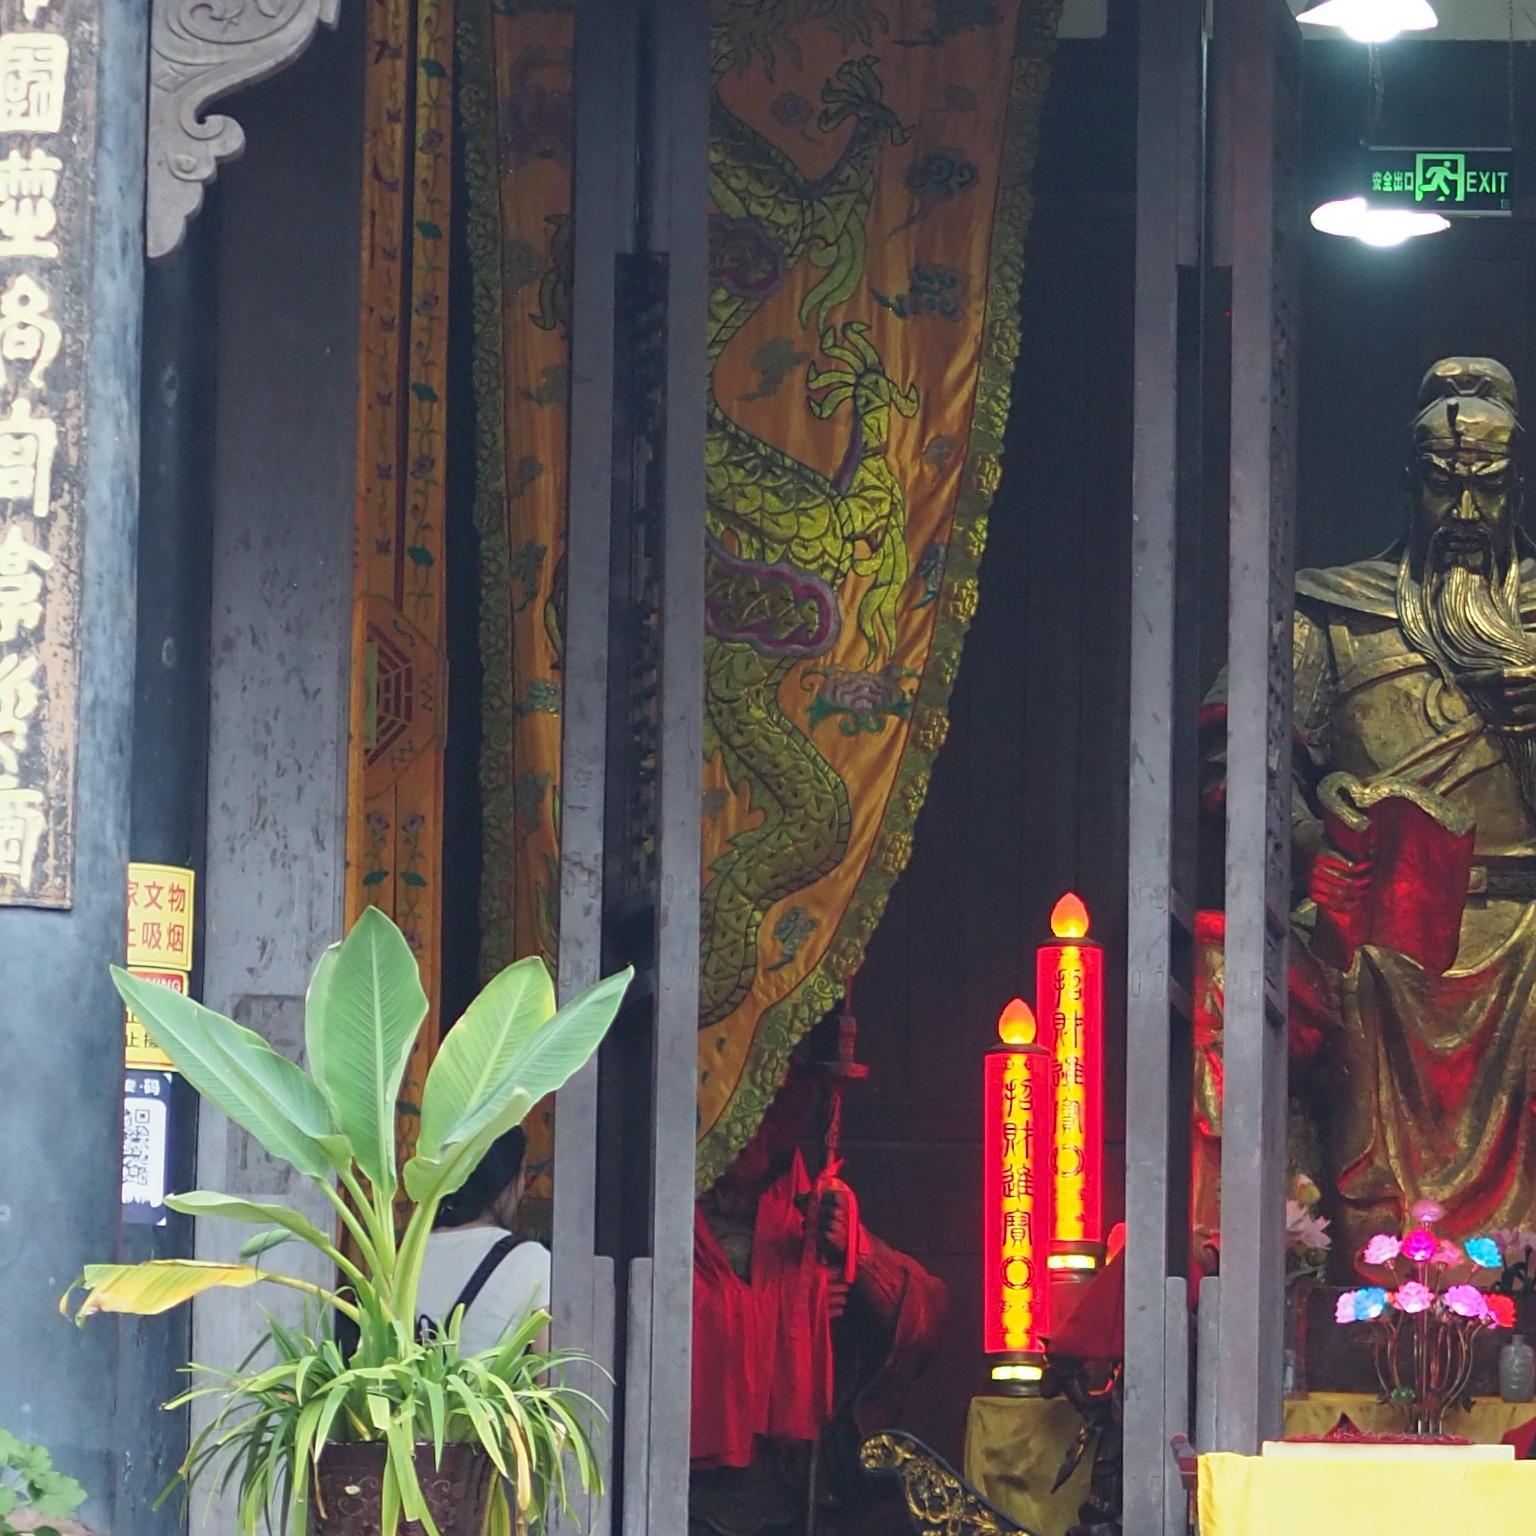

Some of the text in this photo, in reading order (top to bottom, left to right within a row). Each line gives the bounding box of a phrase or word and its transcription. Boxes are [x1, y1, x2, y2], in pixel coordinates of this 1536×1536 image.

[1372, 171, 1414, 192] 安全出口
[1466, 171, 1509, 193] EXIT
